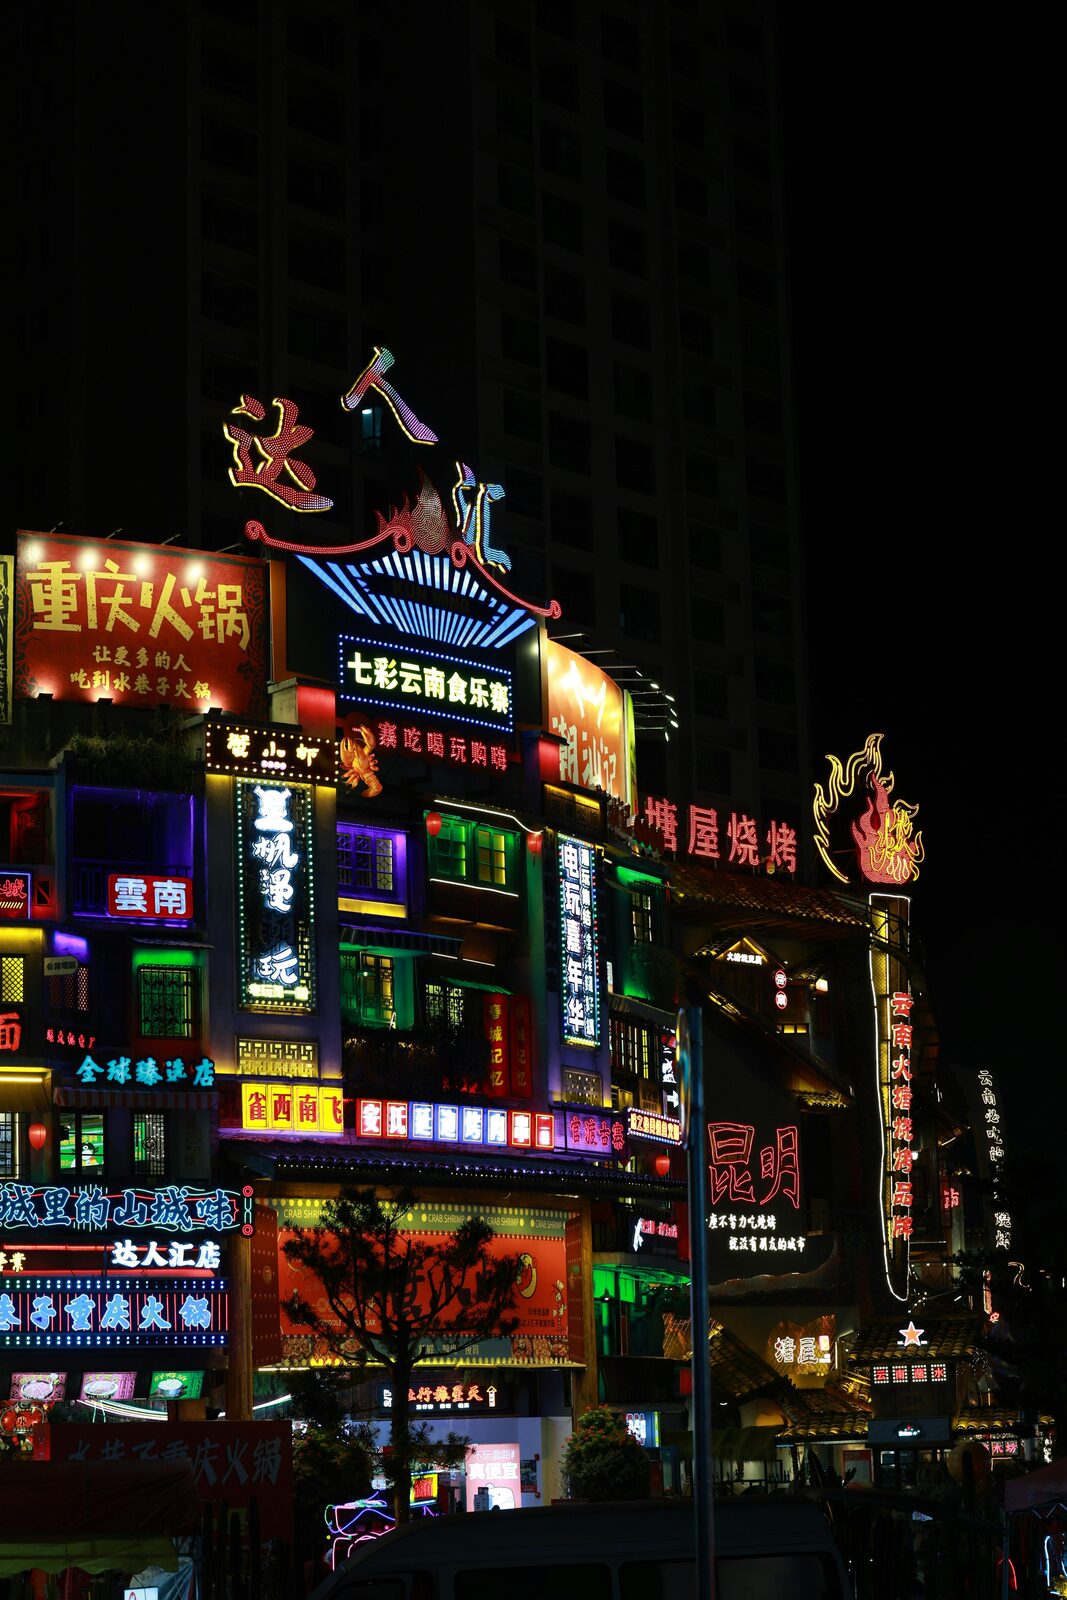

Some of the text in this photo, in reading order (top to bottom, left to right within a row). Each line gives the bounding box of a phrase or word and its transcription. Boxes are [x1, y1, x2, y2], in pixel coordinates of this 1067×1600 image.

[26, 558, 251, 650] 重庆火锅
[93, 645, 192, 672] 让更多的人
[70, 669, 212, 701] 吃到水巷子火锅
[347, 651, 510, 714] 七彩云南食乐寨
[114, 877, 187, 915] 雲南
[488, 1004, 504, 1087] 春城记忆
[890, 992, 914, 1240] 云南火塘烧烤品牌
[707, 1122, 801, 1210] 昆明
[283, 1209, 302, 1219] CRAB
[705, 1213, 776, 1230] 座不努力吃烧烤
[111, 1240, 220, 1269] 达人汇店
[729, 1235, 806, 1252] 就没有朋友的城市
